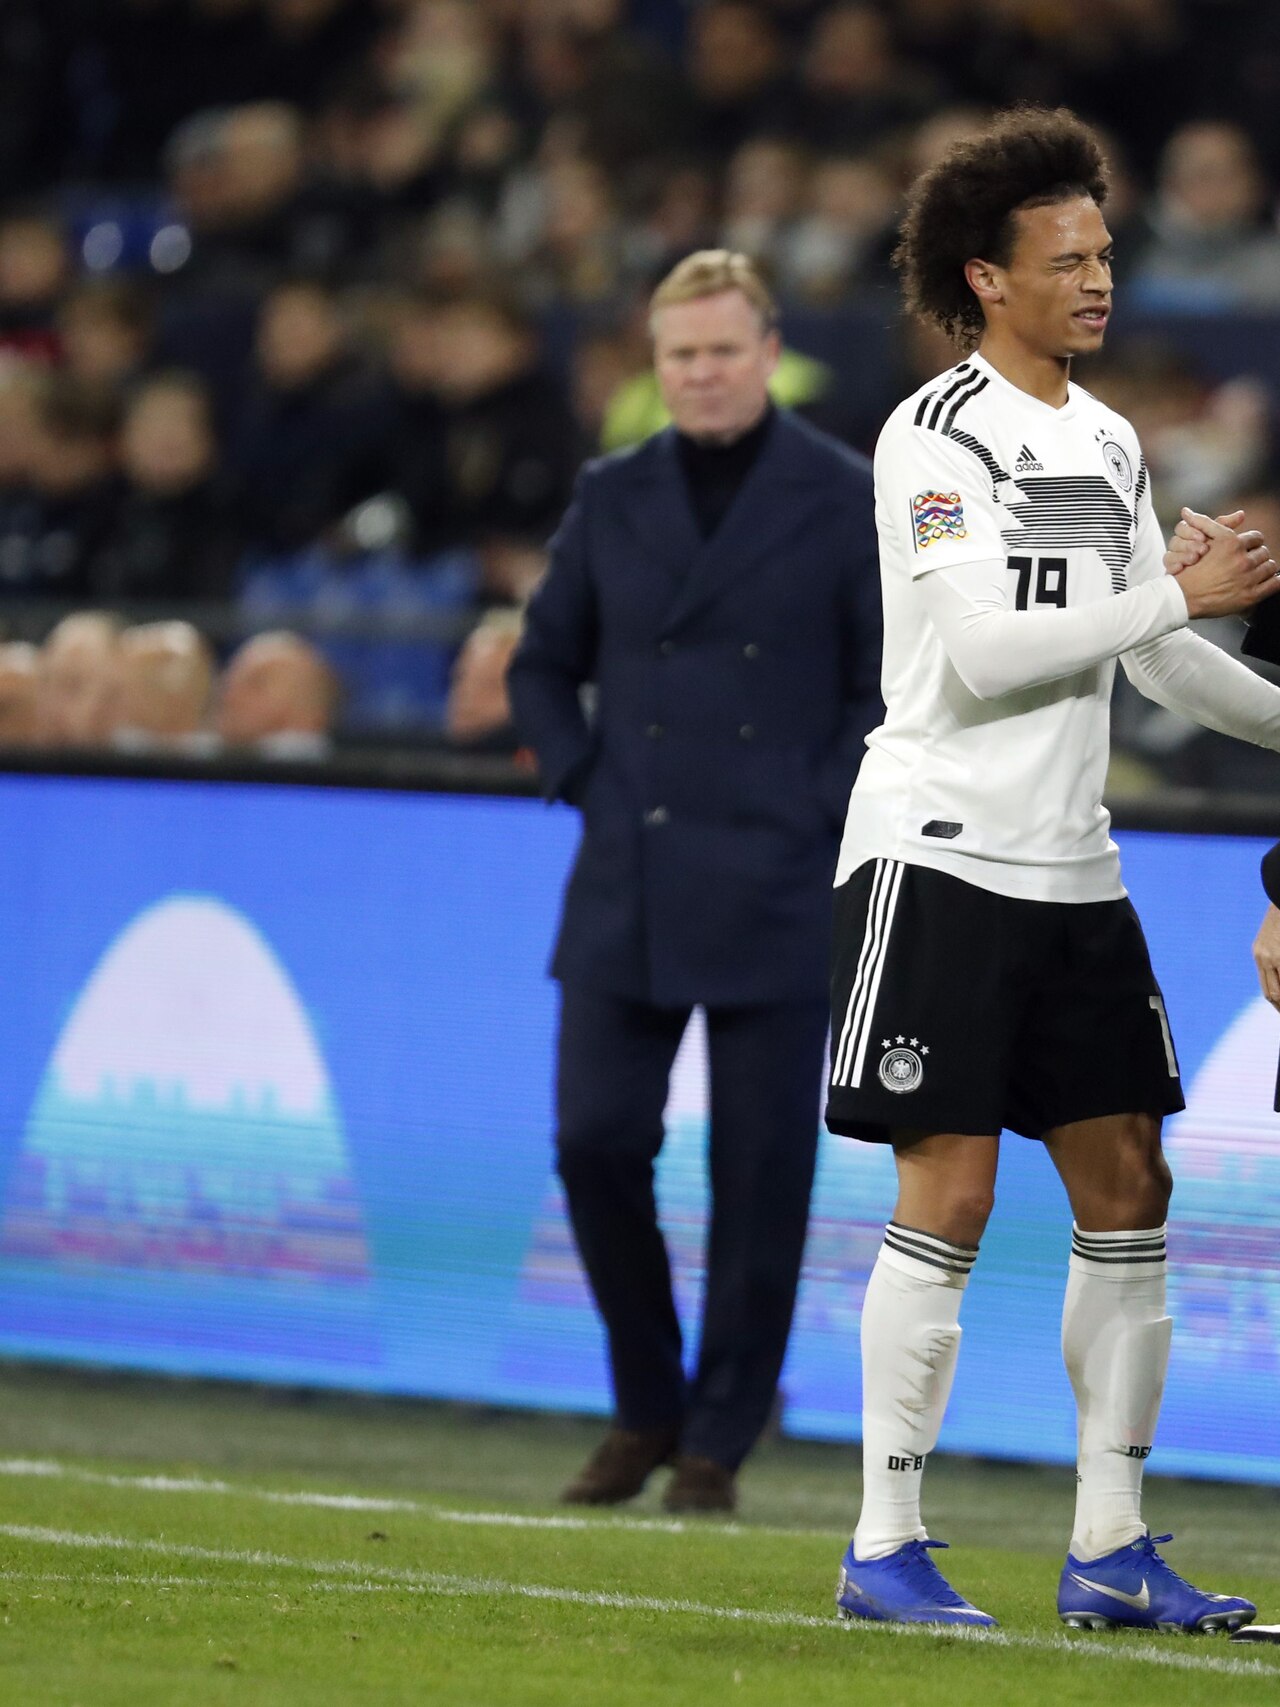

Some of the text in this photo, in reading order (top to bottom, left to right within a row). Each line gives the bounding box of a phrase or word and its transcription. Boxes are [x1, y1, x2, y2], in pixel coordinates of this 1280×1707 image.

[1015, 461, 1044, 472] adidas
[1007, 555, 1067, 611] 19
[888, 1455, 923, 1471] DFB
